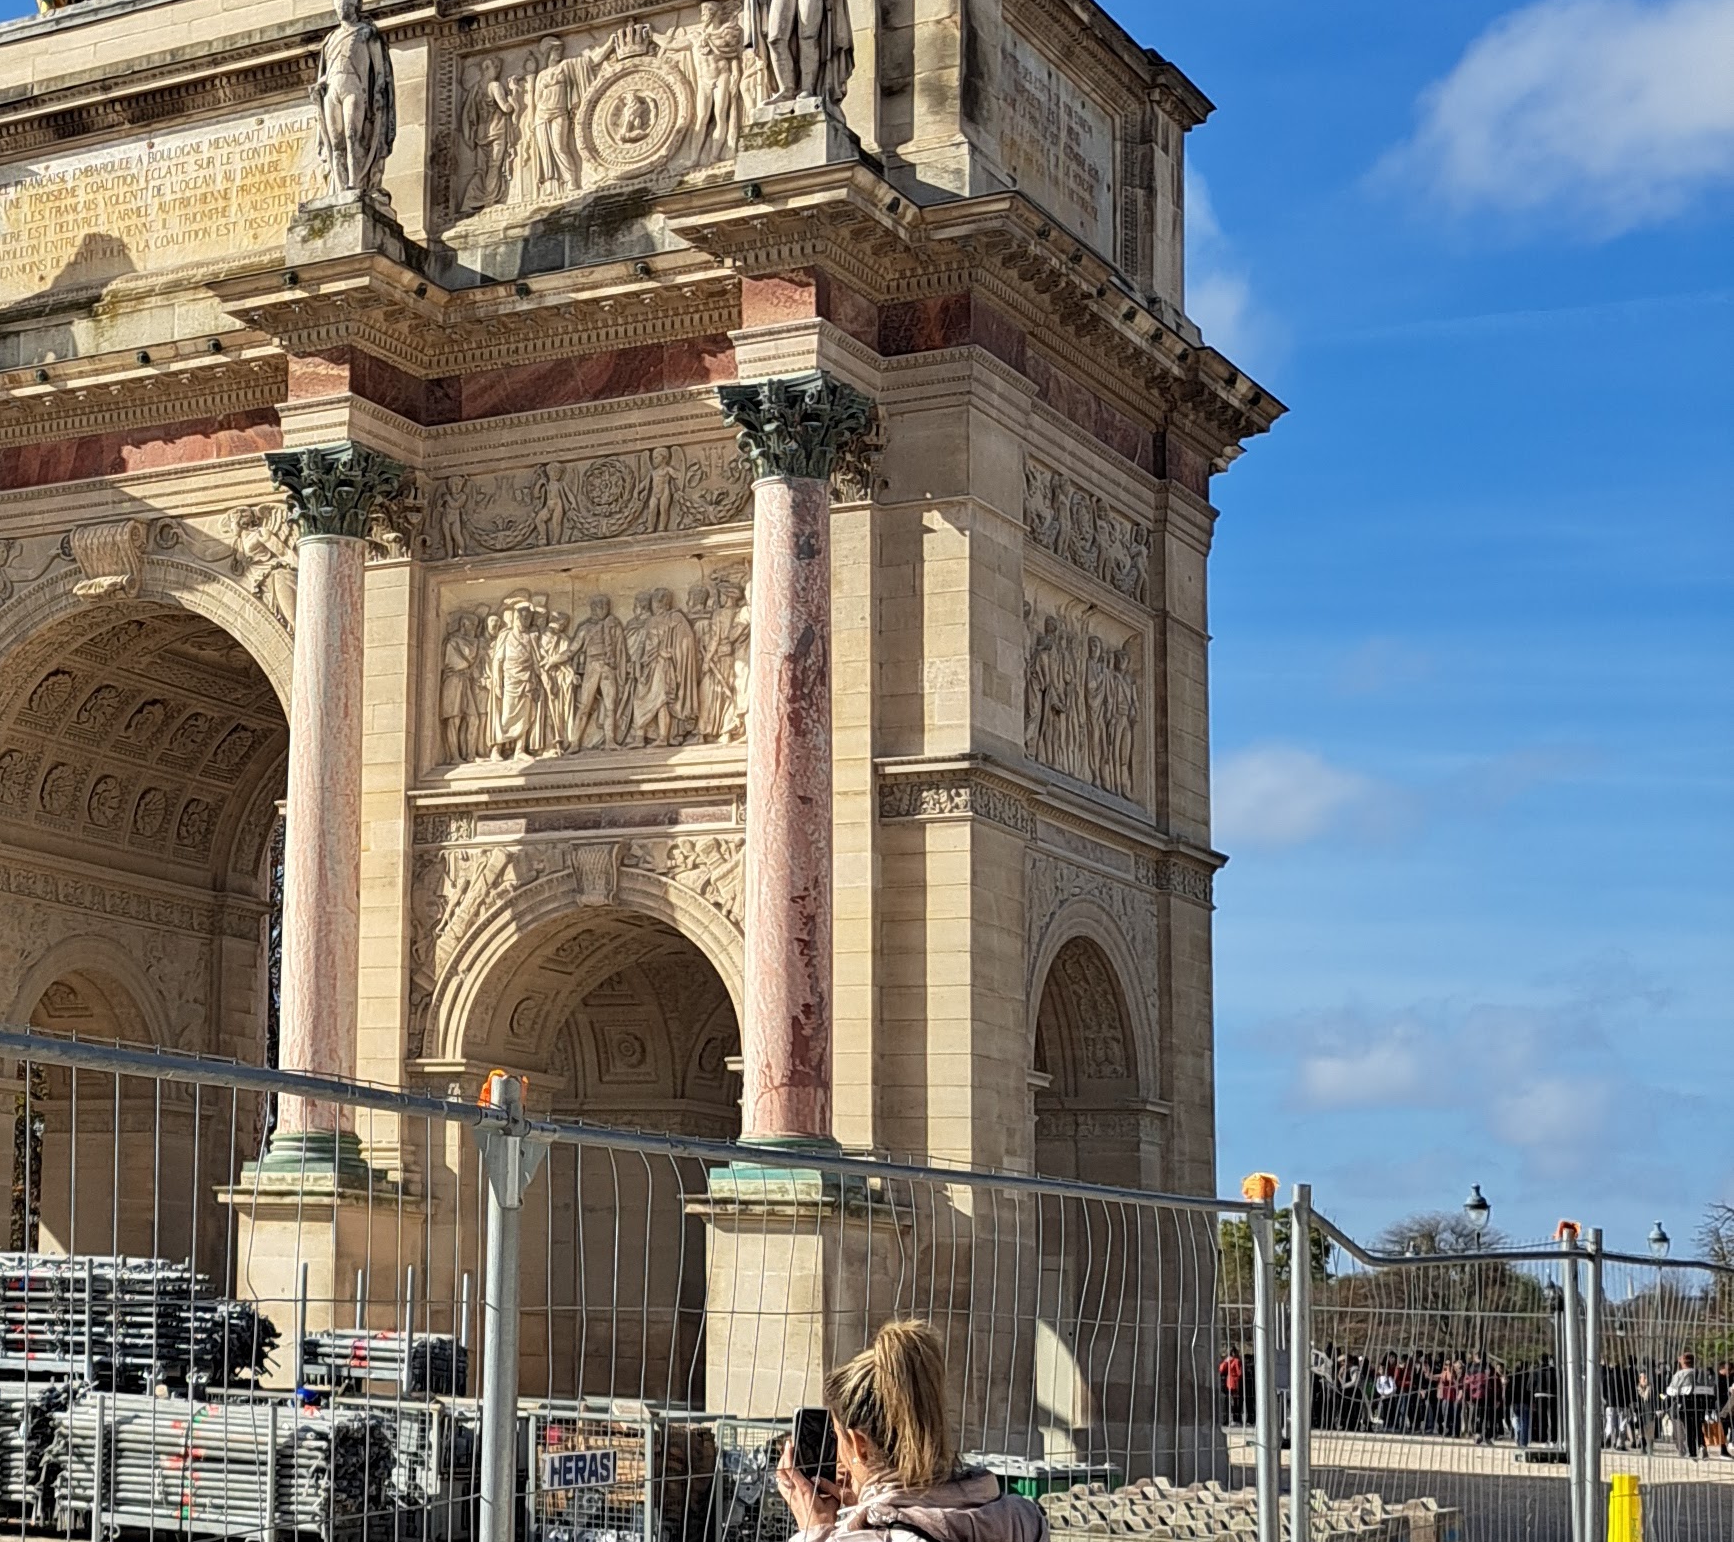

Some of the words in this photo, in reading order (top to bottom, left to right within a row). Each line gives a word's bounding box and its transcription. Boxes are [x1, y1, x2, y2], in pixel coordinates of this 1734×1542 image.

[148, 141, 203, 164] BOULOGNE
[268, 116, 317, 139] L'ANGLE
[24, 209, 44, 224] LES
[102, 187, 146, 207] VOLENT
[152, 184, 165, 197] DE
[221, 168, 236, 184] AU
[85, 171, 139, 195] COALITION
[194, 156, 215, 172] SUR
[221, 152, 233, 166] LE
[28, 225, 48, 240] EST
[157, 187, 231, 214] AUTRICHIENNE
[45, 235, 78, 253] ENTRE
[177, 204, 230, 227] TRIOMPHE
[0, 265, 13, 279] EN
[17, 259, 46, 276] MOINS
[51, 255, 63, 269] DE
[68, 250, 95, 266] CENT
[136, 239, 150, 253] LA
[154, 226, 211, 249] COALITION
[216, 221, 237, 237] EST
[550, 1451, 611, 1487] HERAS
